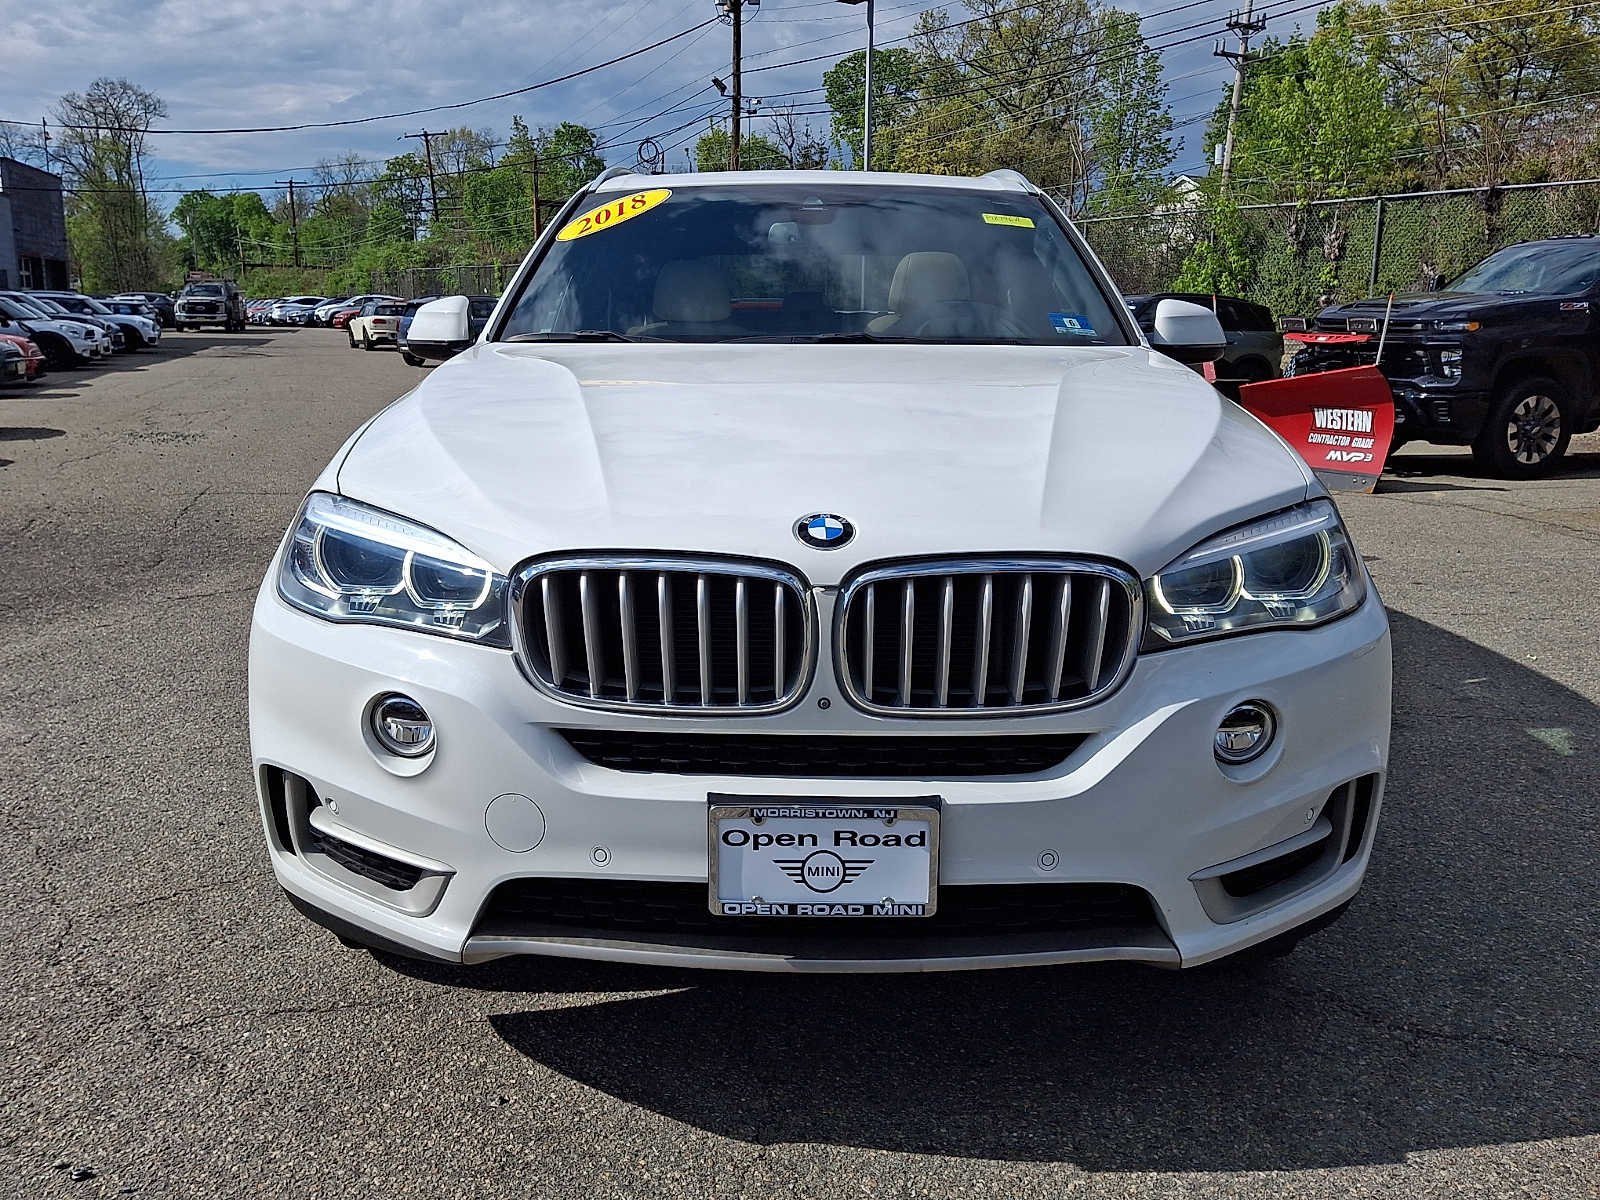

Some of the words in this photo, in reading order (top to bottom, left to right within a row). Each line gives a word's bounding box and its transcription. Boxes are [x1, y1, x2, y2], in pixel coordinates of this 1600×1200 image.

[577, 194, 647, 235] 2018
[1314, 407, 1373, 433] WESTERN
[1308, 432, 1351, 447] CONTRACTOR
[1351, 437, 1375, 449] GRADE
[873, 810, 895, 819] NJ
[721, 829, 818, 851] Open
[833, 830, 926, 847] Road
[807, 866, 840, 877] MINI
[723, 903, 789, 916] OPEN
[797, 903, 865, 916] ROAD
[872, 904, 923, 916] MINI
